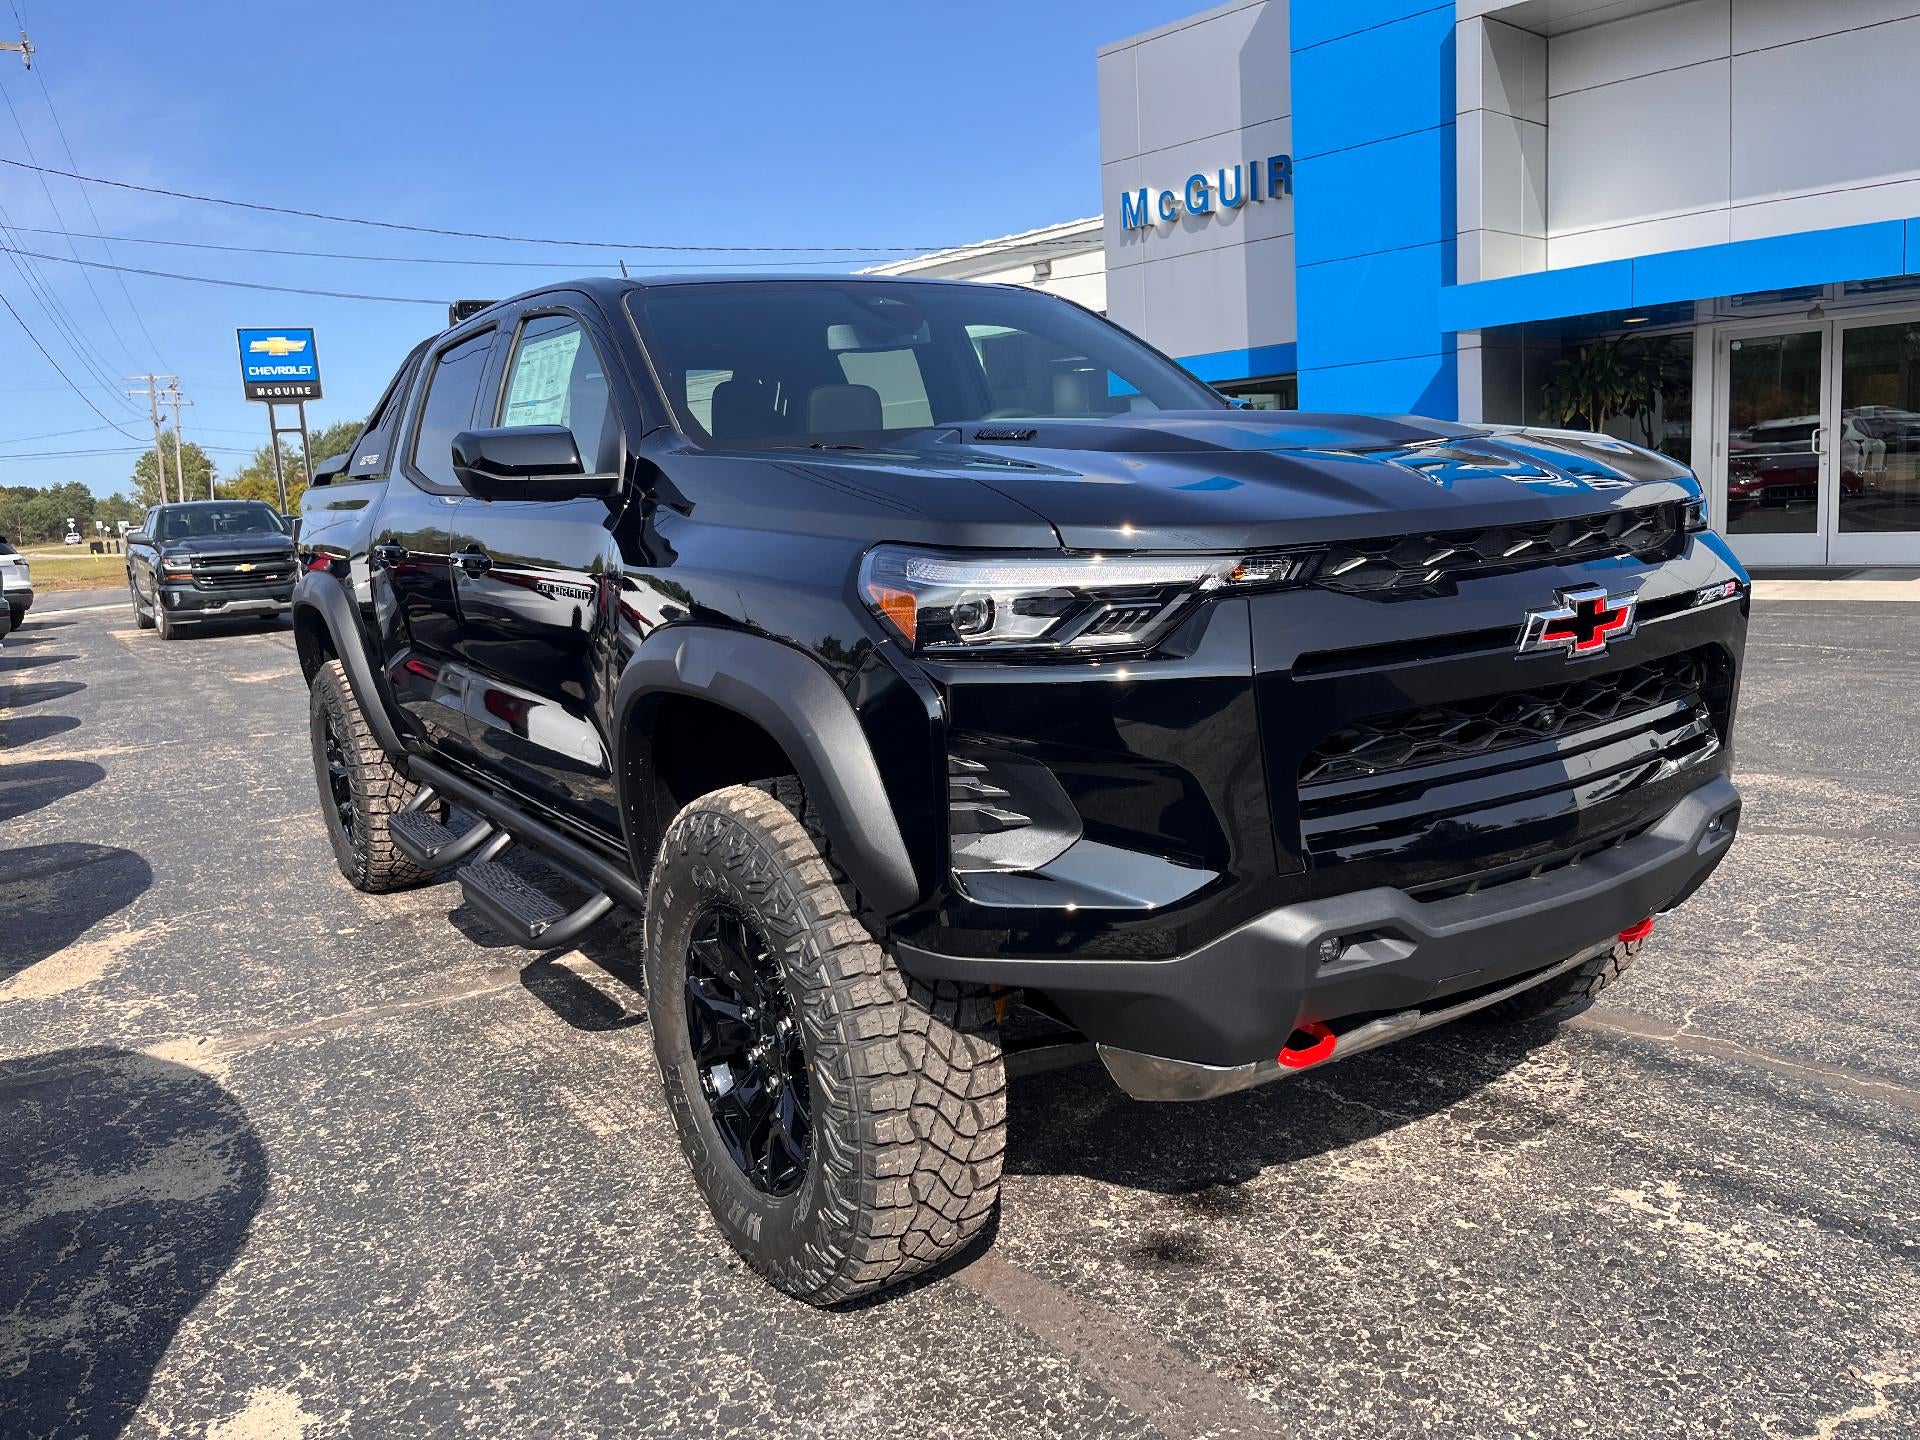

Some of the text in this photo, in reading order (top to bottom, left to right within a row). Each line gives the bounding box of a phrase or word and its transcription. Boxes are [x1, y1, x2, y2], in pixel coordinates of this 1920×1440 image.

[248, 365, 312, 375] CHEVROLET
[257, 386, 311, 396] McGUIRE
[1697, 581, 1736, 606] ZR2
